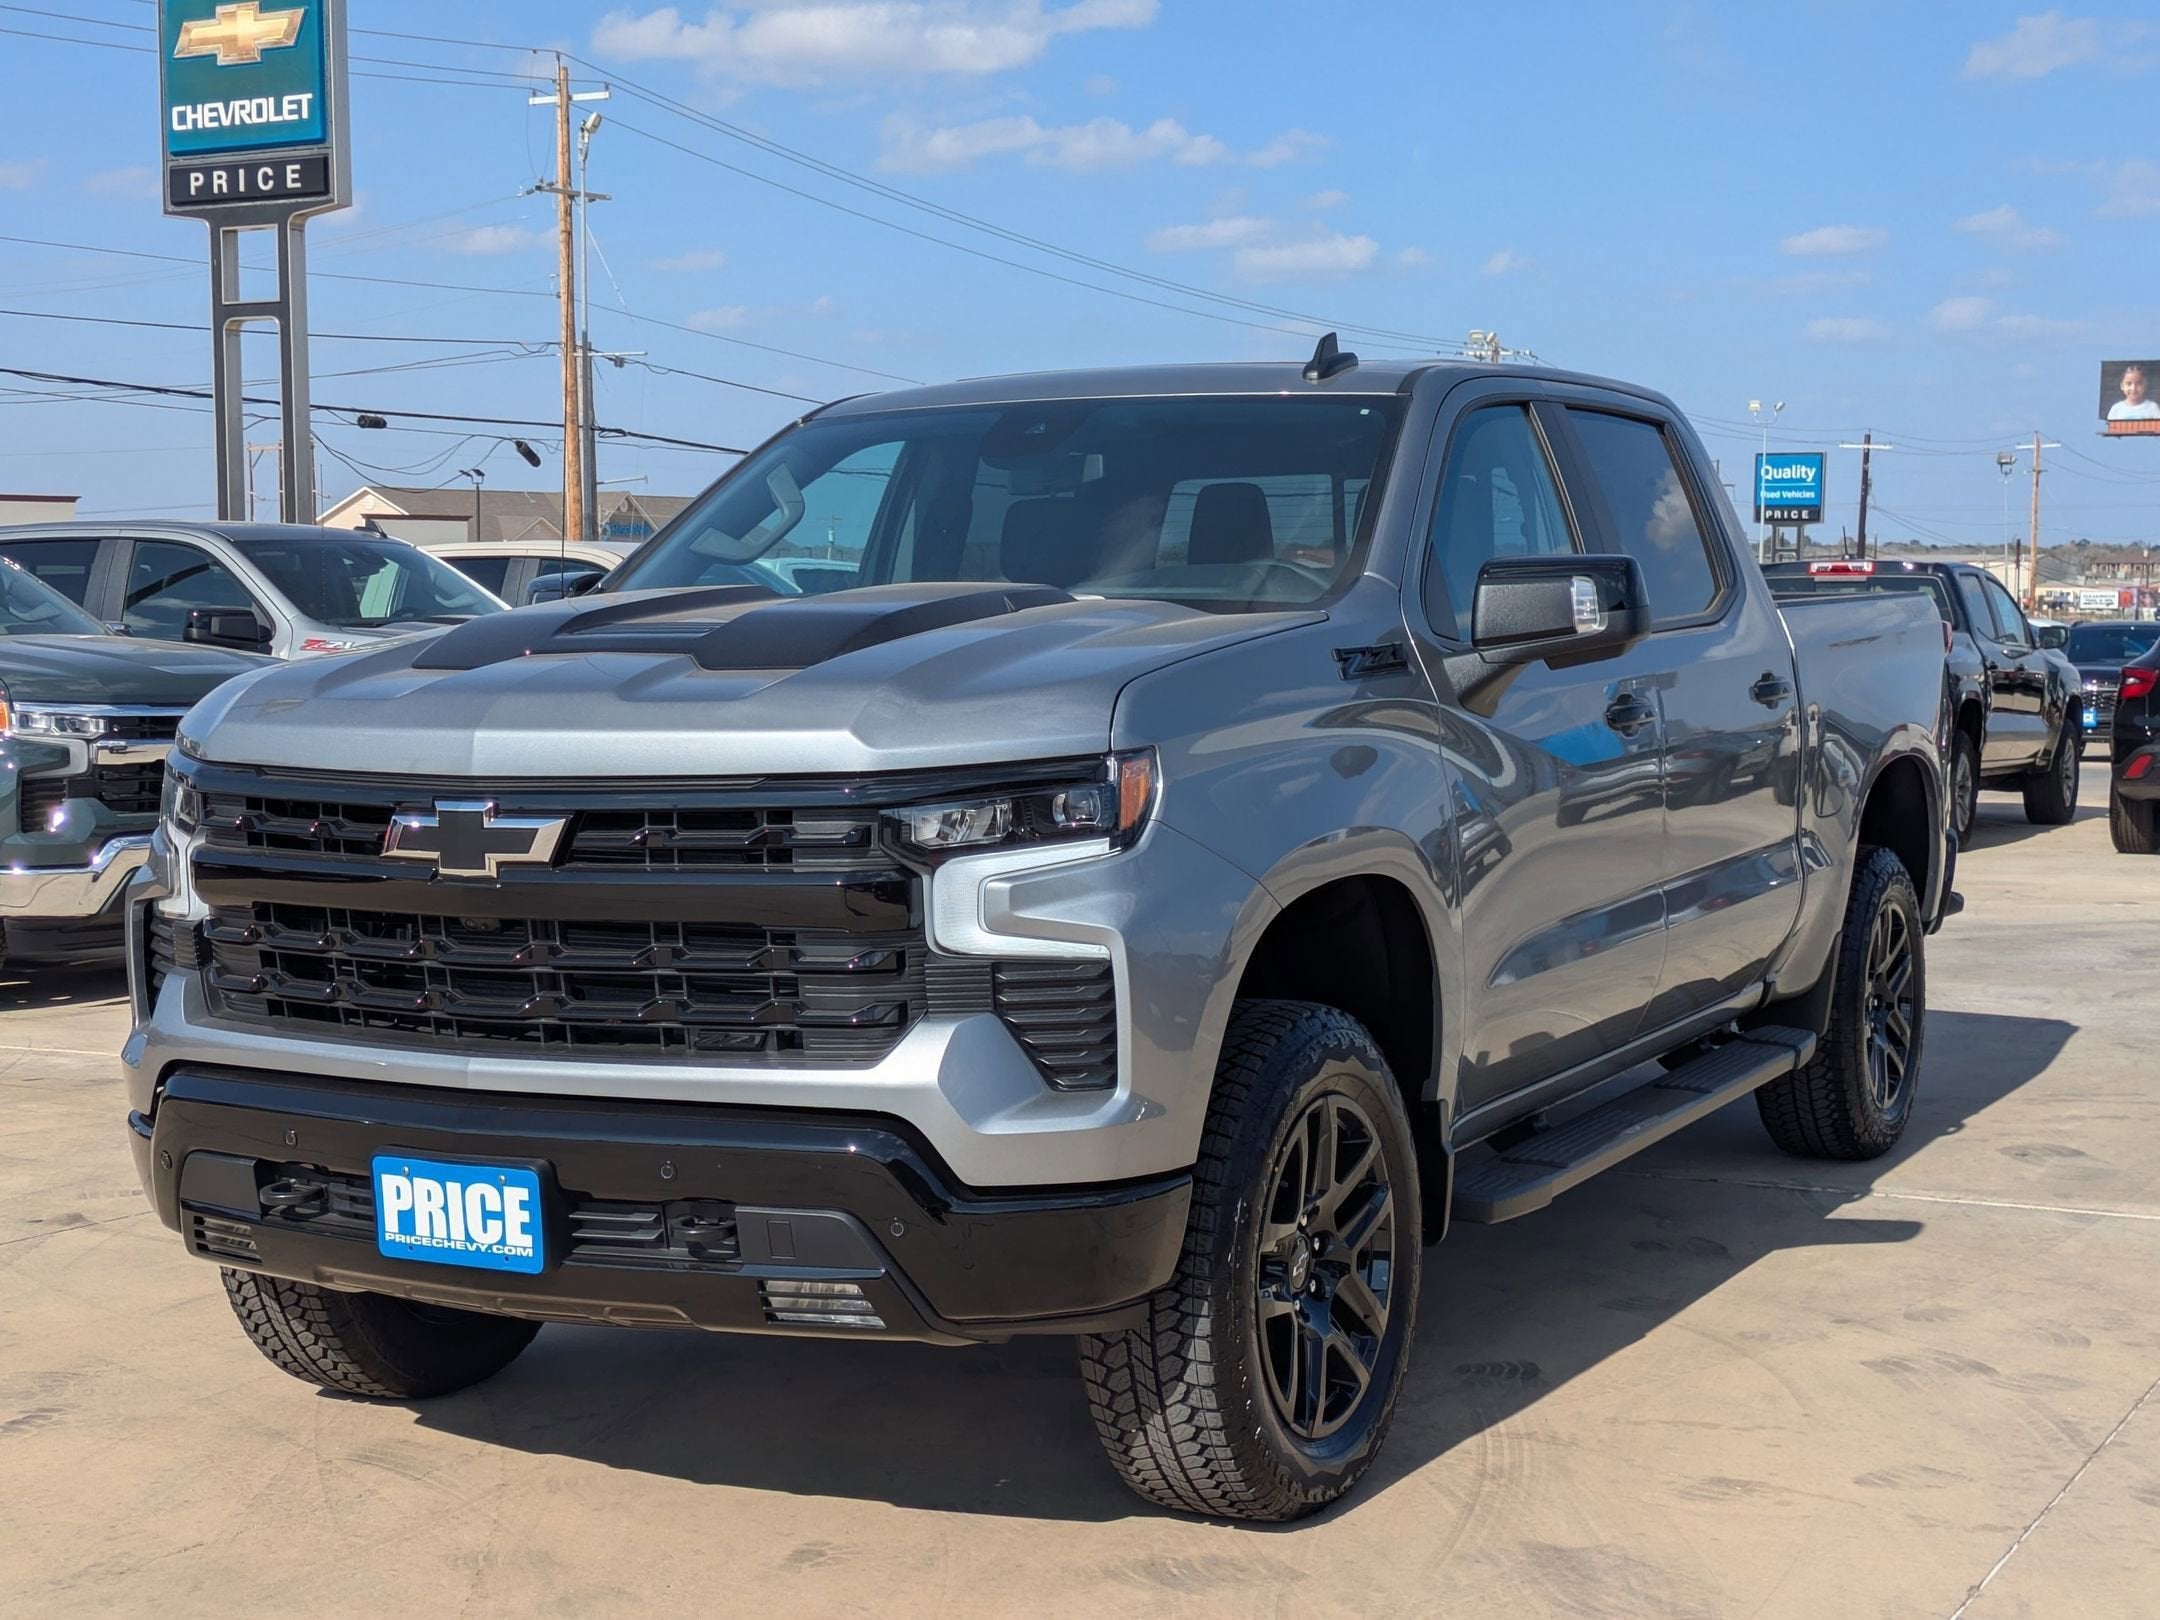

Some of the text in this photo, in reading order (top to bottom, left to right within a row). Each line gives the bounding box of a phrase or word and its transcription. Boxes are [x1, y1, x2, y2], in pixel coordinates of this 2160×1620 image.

[172, 93, 312, 131] CHEVROLET
[189, 164, 302, 196] PRICE
[1761, 464, 1816, 482] Quality
[1782, 489, 1815, 498] Vehicles
[1765, 510, 1809, 519] PRICE
[380, 1173, 533, 1248] PRICE
[384, 1231, 533, 1258] PRICECHEVY.COM
